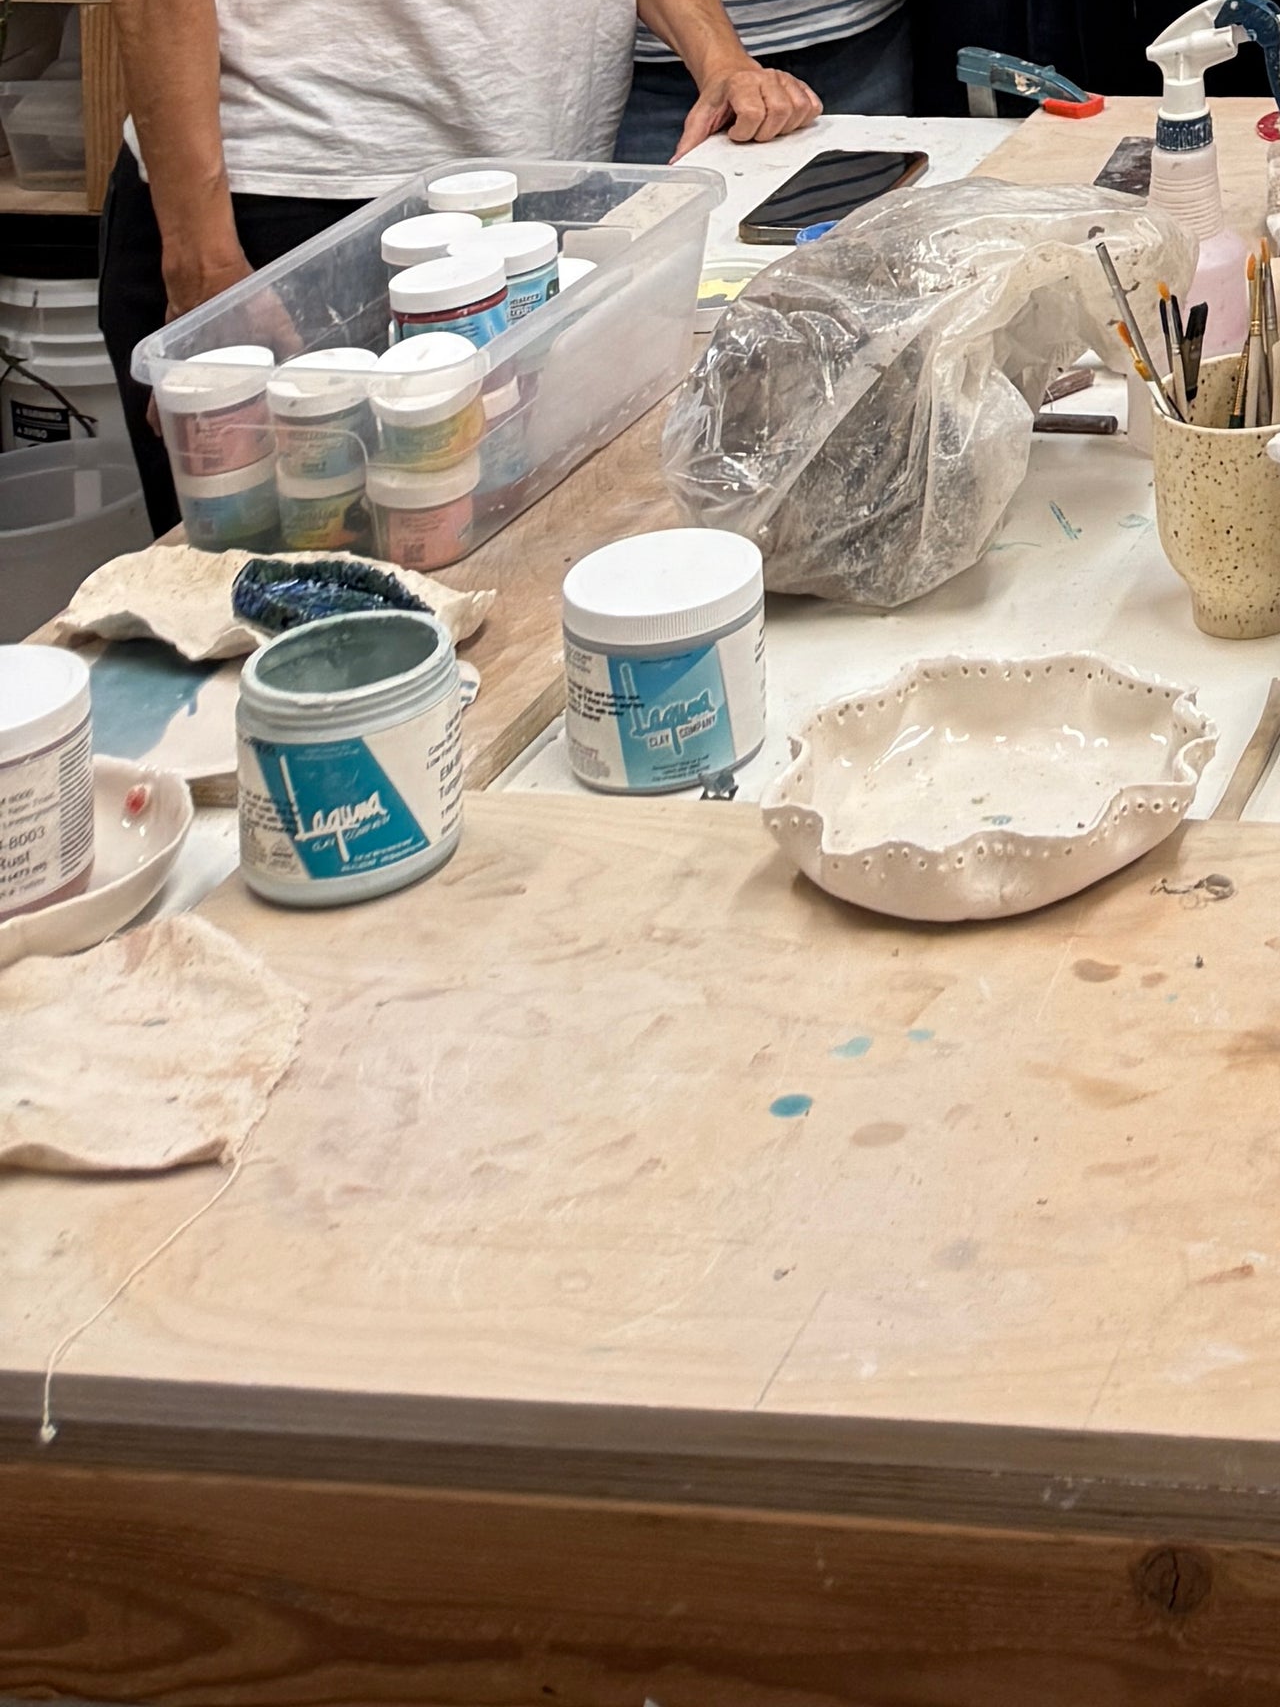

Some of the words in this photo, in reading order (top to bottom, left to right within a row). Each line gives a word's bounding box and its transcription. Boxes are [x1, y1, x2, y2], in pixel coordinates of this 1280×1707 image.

[618, 661, 719, 757] Laguna
[648, 734, 670, 749] CLAY
[294, 753, 389, 864] Laguna
